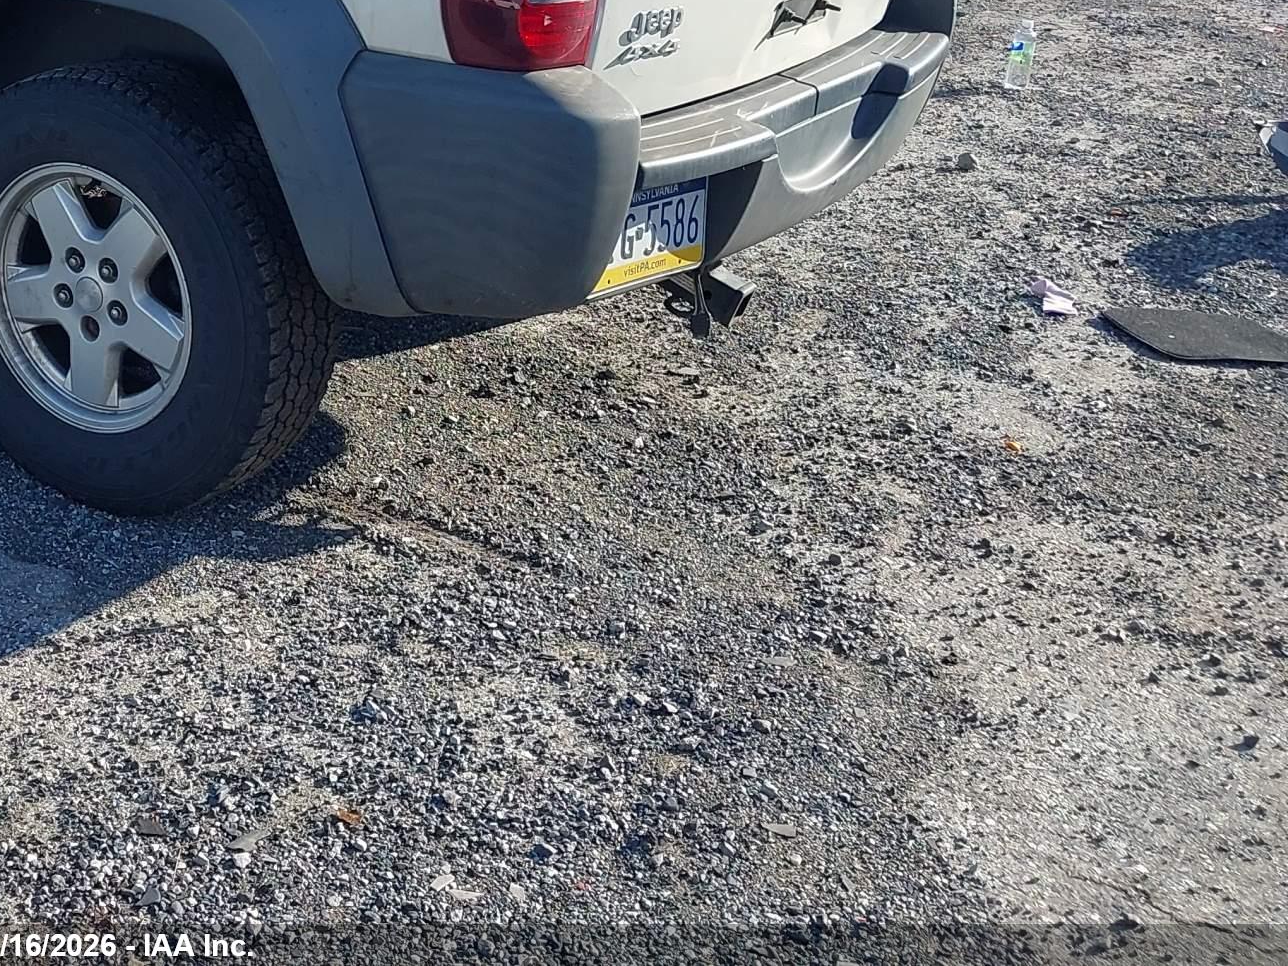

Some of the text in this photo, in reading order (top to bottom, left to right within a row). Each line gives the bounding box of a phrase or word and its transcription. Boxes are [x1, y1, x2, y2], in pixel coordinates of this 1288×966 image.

[618, 8, 682, 47] Jeep
[609, 195, 699, 263] G-5586
[623, 258, 667, 277] visitPA.com
